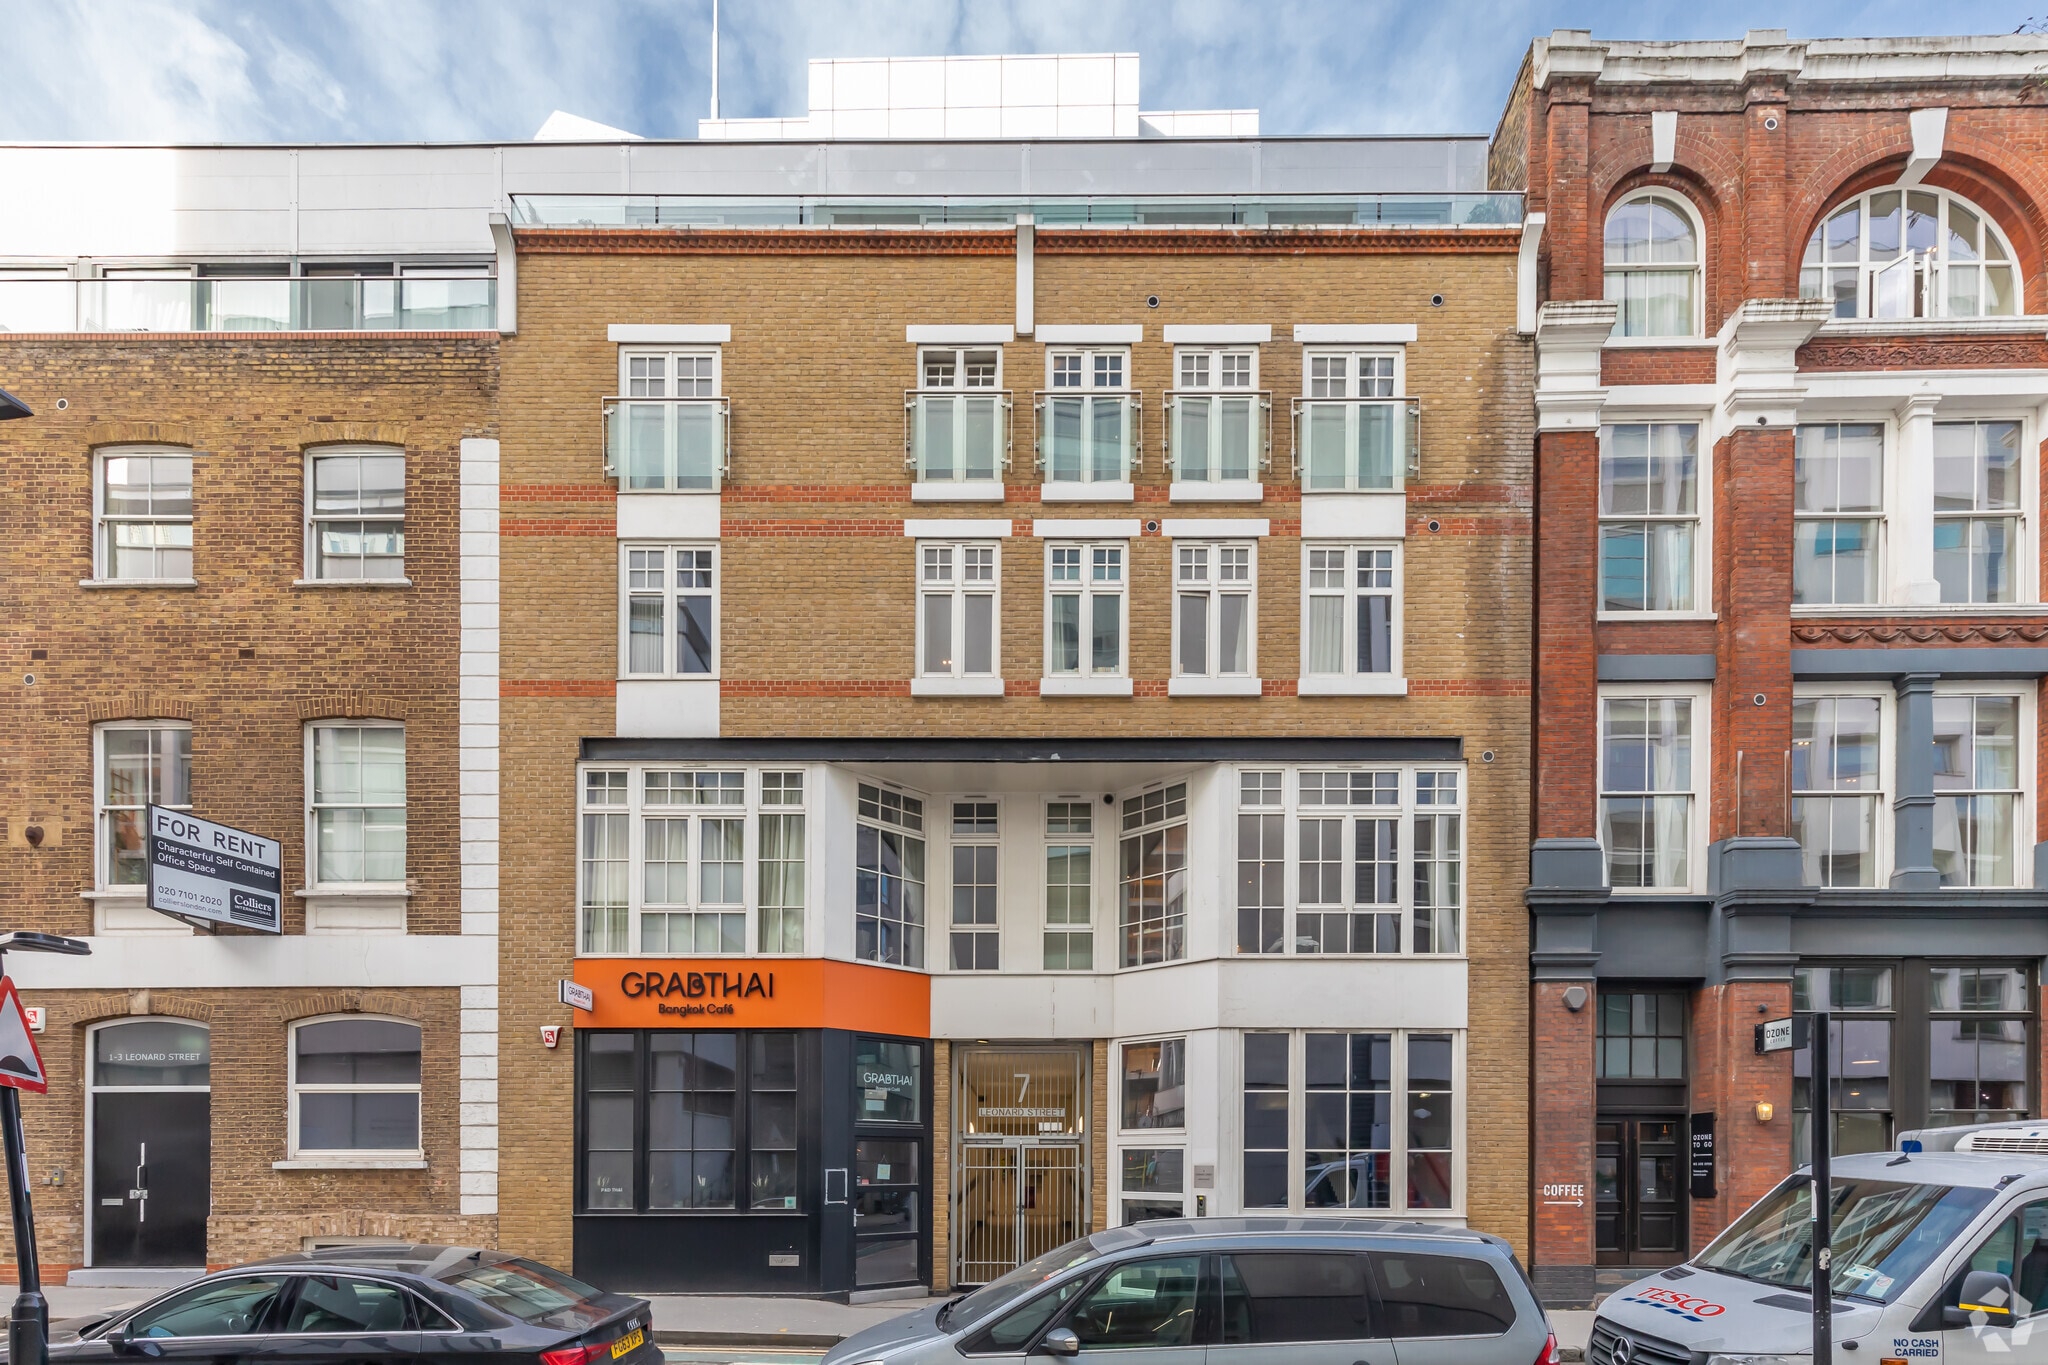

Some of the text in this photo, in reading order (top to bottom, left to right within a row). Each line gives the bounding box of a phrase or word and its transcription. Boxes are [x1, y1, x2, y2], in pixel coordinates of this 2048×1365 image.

[157, 814, 266, 859] FOR RENT
[157, 840, 276, 878] Characterful Self Contained
[157, 852, 216, 875] Office Space
[158, 885, 223, 906] 020 7101 2020
[158, 897, 223, 915] collierslondon.com
[234, 894, 272, 912] Colliers
[234, 905, 272, 917] INTERNATIONAL
[621, 971, 774, 998] GRABTHAI
[658, 1003, 734, 1017] Bangkok Café
[1765, 1026, 1790, 1039] OZONE
[109, 1053, 201, 1061] 1-3 LEONARD STREET
[863, 1072, 913, 1086] GRABTHAI
[1013, 1073, 1030, 1103] 7
[980, 1108, 1064, 1116] LEONARD STREET
[1692, 1133, 1712, 1141] OZONE
[1543, 1184, 1584, 1196] COFFEE
[1637, 1287, 1726, 1317] TESCO
[1893, 1338, 1939, 1348] NO CASH
[1894, 1348, 1939, 1357] CARRIED
